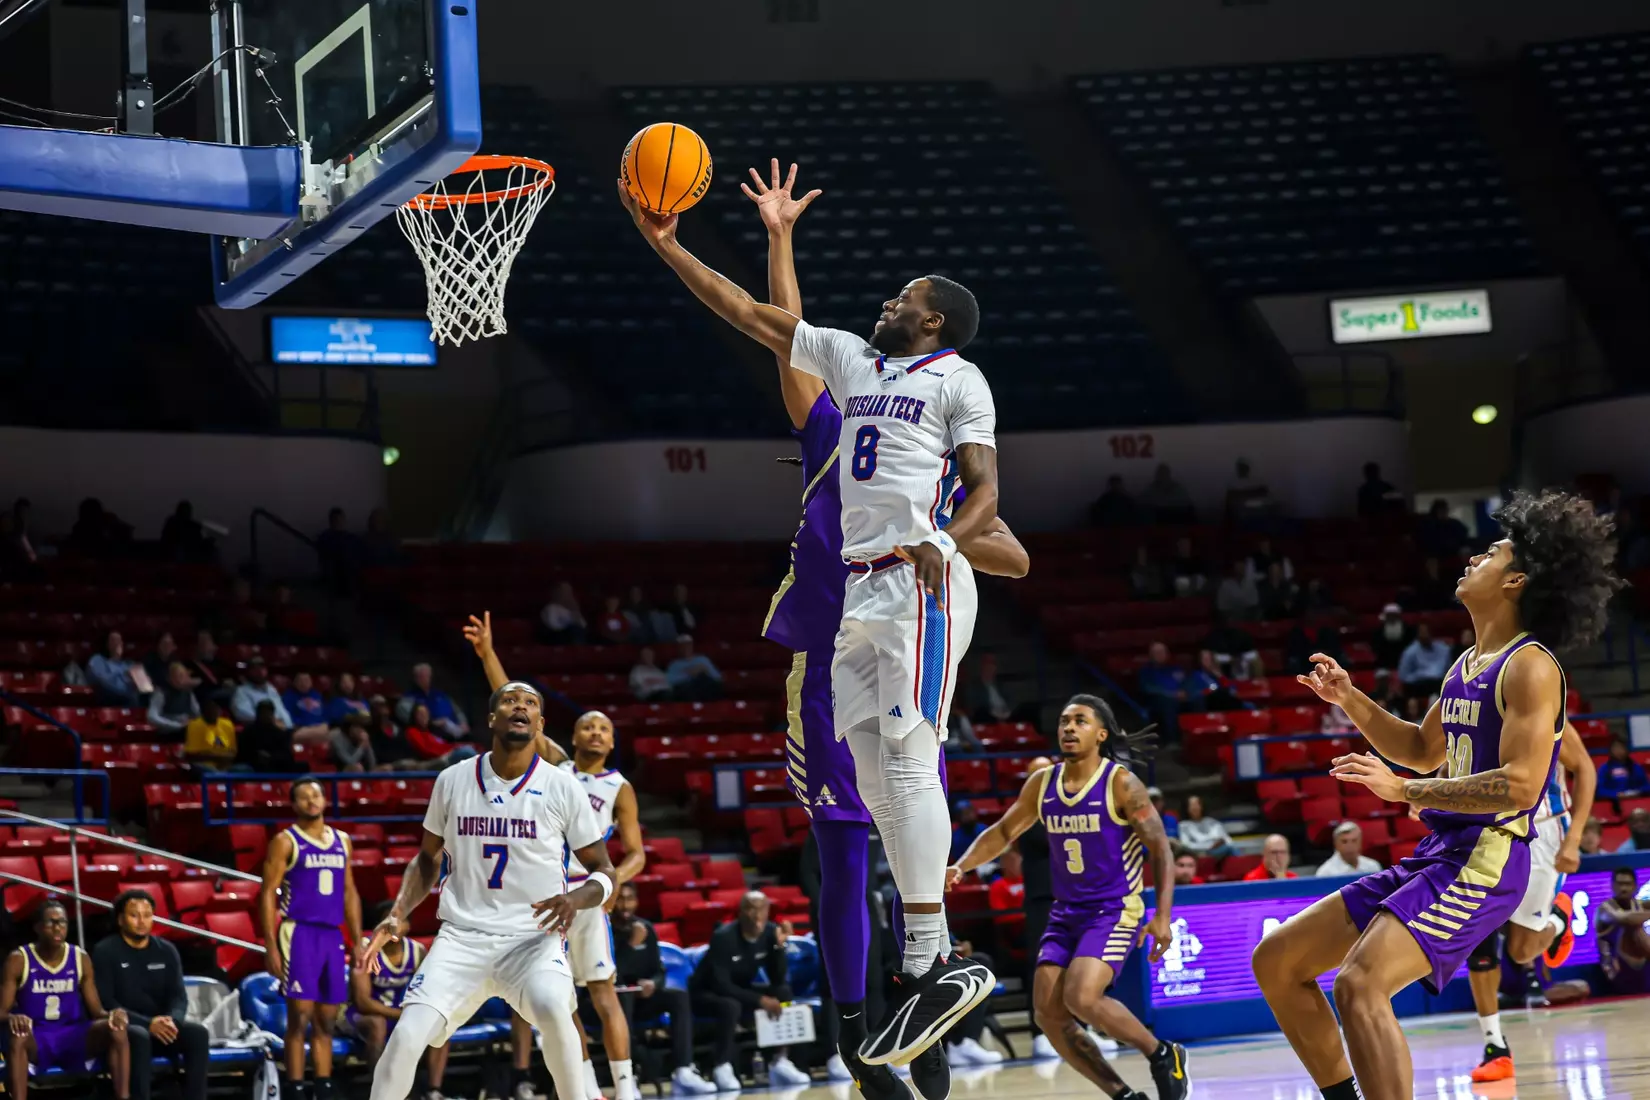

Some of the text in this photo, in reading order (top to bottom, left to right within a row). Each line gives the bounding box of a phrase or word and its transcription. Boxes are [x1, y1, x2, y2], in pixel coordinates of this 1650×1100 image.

[1340, 301, 1479, 332] Super 1 Foods
[888, 395, 926, 425] TECH
[851, 424, 881, 481] 8
[1108, 433, 1155, 459] 102
[664, 447, 706, 473] 101
[1405, 775, 1508, 800] Roberts
[457, 816, 537, 839] LOUISIANA TECH
[1046, 814, 1101, 833] ALCORN
[482, 843, 509, 890] 7
[1063, 838, 1085, 874] 3
[318, 868, 334, 895] 0
[44, 995, 61, 1021] 2
